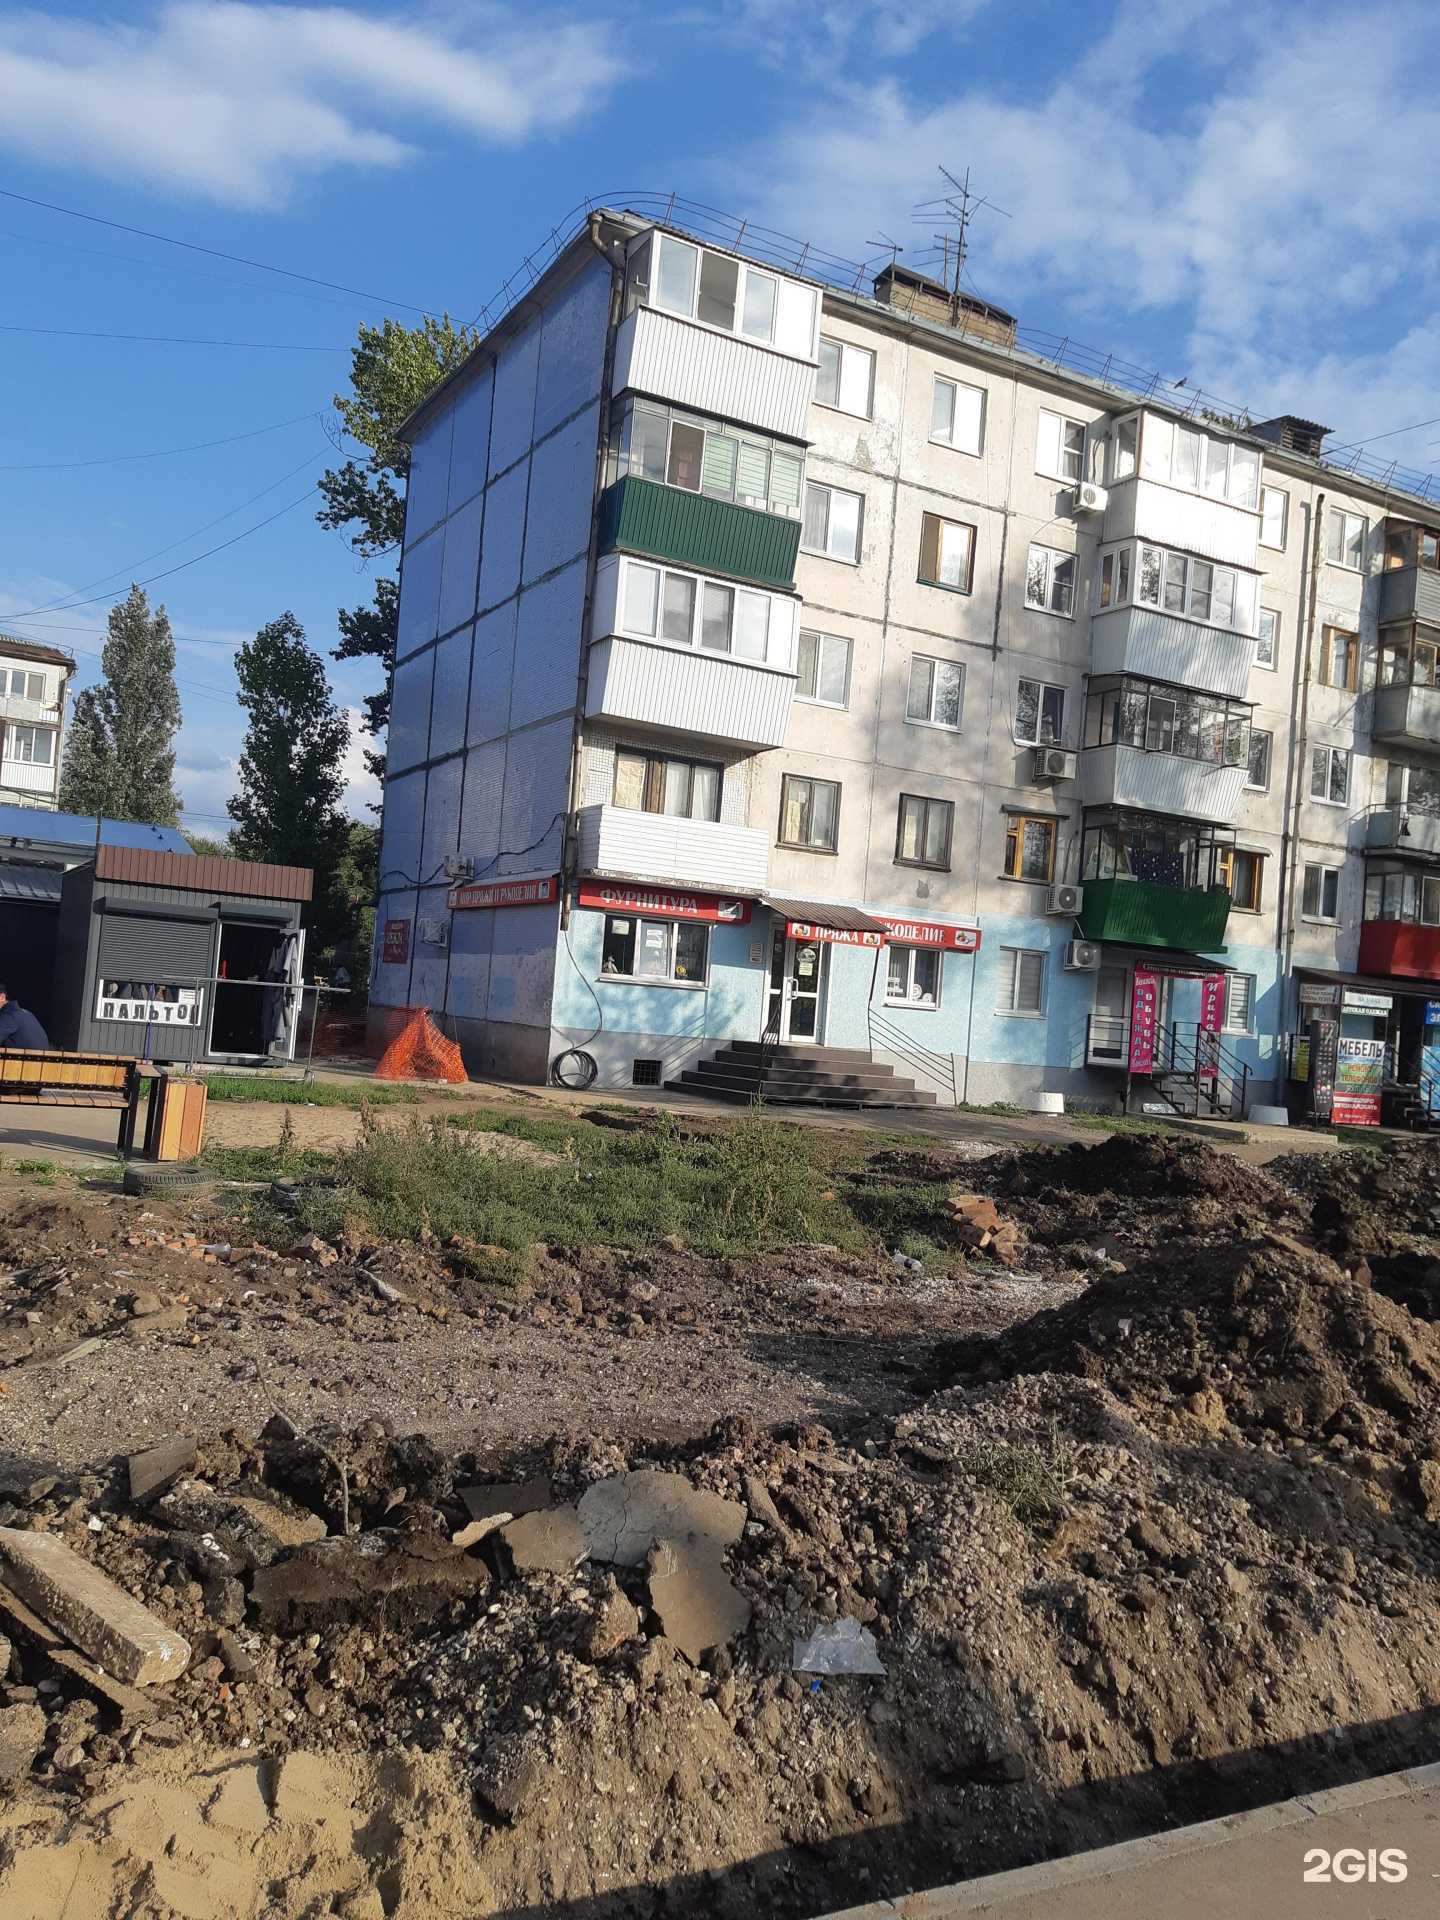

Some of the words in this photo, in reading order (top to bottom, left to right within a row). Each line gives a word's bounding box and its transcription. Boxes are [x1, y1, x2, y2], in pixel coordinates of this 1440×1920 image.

[600, 888, 698, 914] ФУРНИТУРА
[814, 926, 860, 943] ПРЯЖА
[880, 920, 945, 943] КОДЕЛИЕ
[1338, 1039, 1383, 1058] МЕБЕЛЬ
